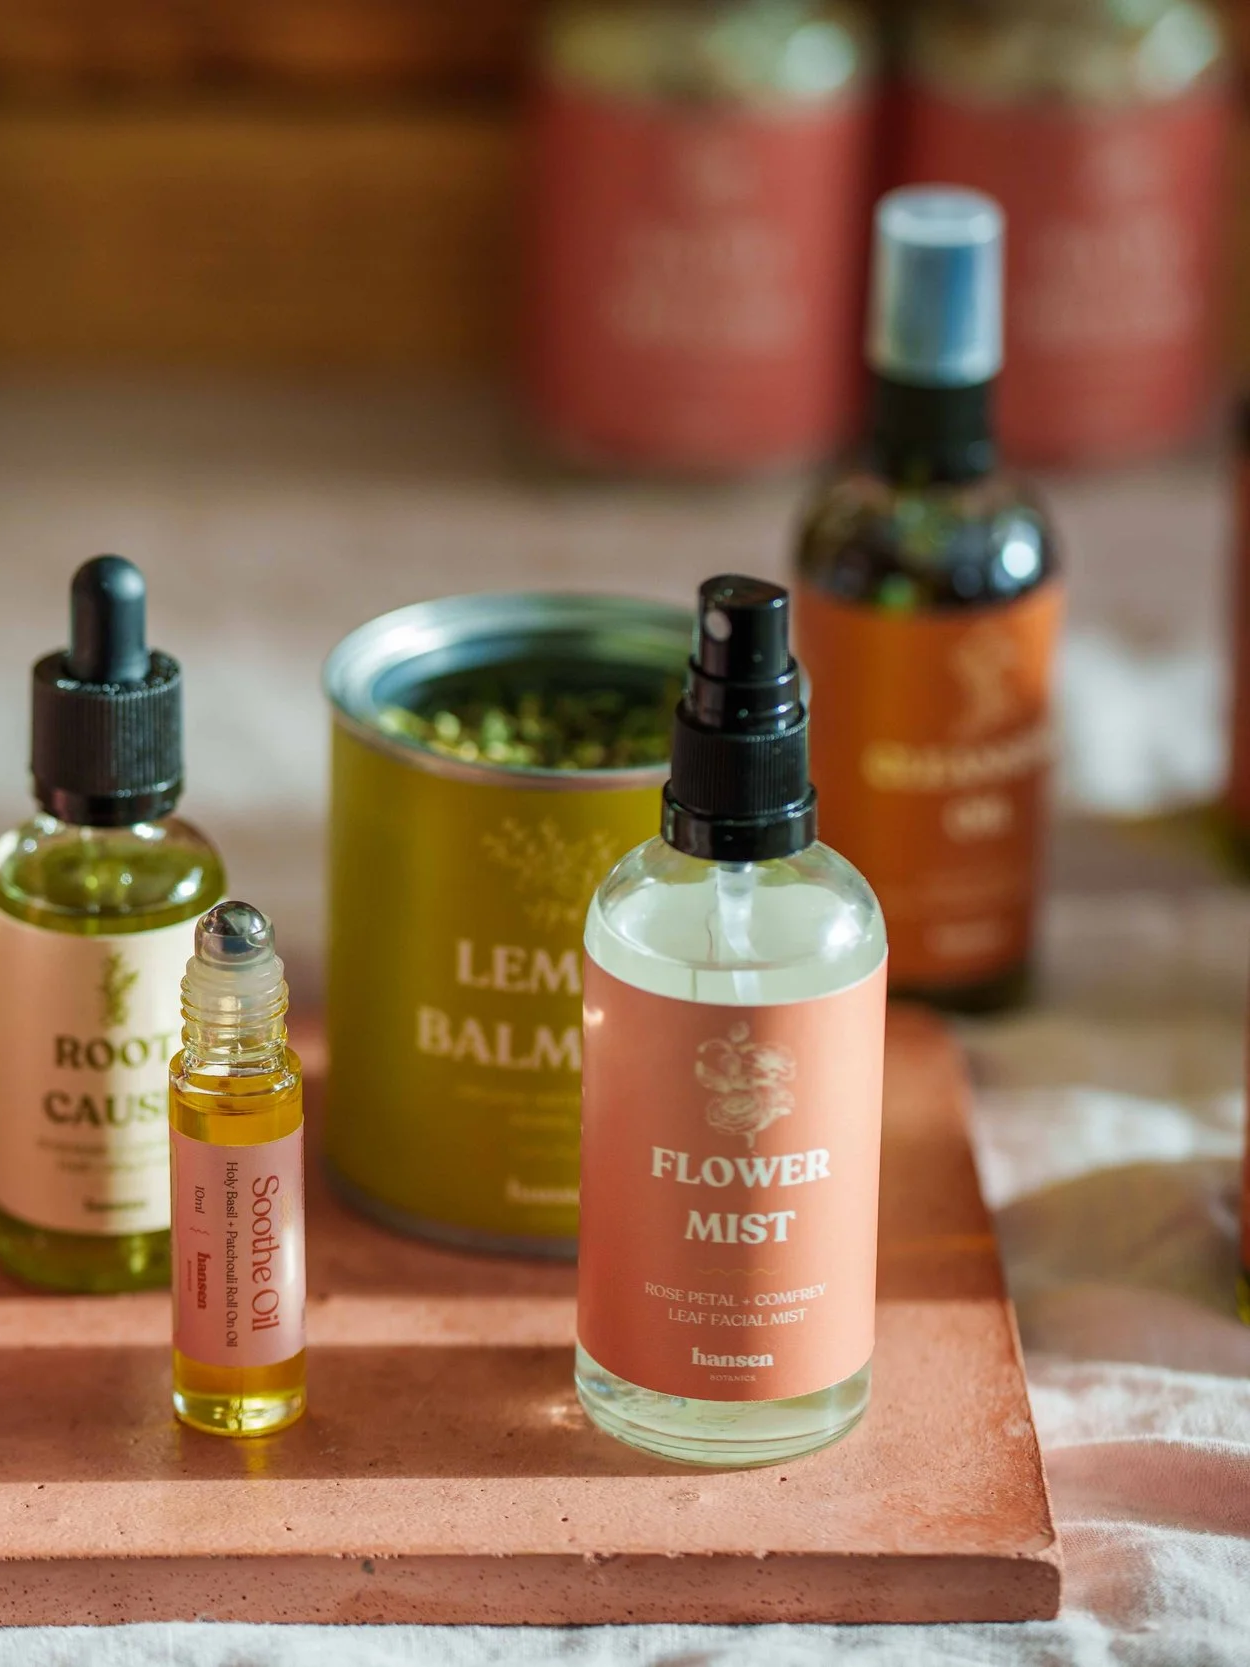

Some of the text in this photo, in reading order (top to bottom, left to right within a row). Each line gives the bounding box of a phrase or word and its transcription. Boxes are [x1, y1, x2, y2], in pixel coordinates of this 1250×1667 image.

[455, 939, 582, 996] LEM
[54, 1033, 174, 1072] ROOT
[415, 1005, 583, 1073] BALM
[42, 1089, 169, 1129] CAUS
[223, 1162, 238, 1188] Holy
[651, 1145, 831, 1189] FLOWER
[194, 1186, 205, 1214] 10ml
[226, 1190, 238, 1218] Basil
[683, 1209, 796, 1245] MIST
[226, 1230, 238, 1284] Patchouli
[252, 1175, 280, 1332] Soothe Oil
[197, 1251, 211, 1310] hansen
[644, 1281, 827, 1307] ROSE PETAL + COMFREY
[226, 1286, 238, 1308] Roll
[226, 1310, 238, 1328] On
[668, 1306, 809, 1327] LEAF FACIAL MIST
[226, 1329, 238, 1348] Oil
[691, 1347, 774, 1367] hansen
[709, 1374, 756, 1382] BOTANICS
